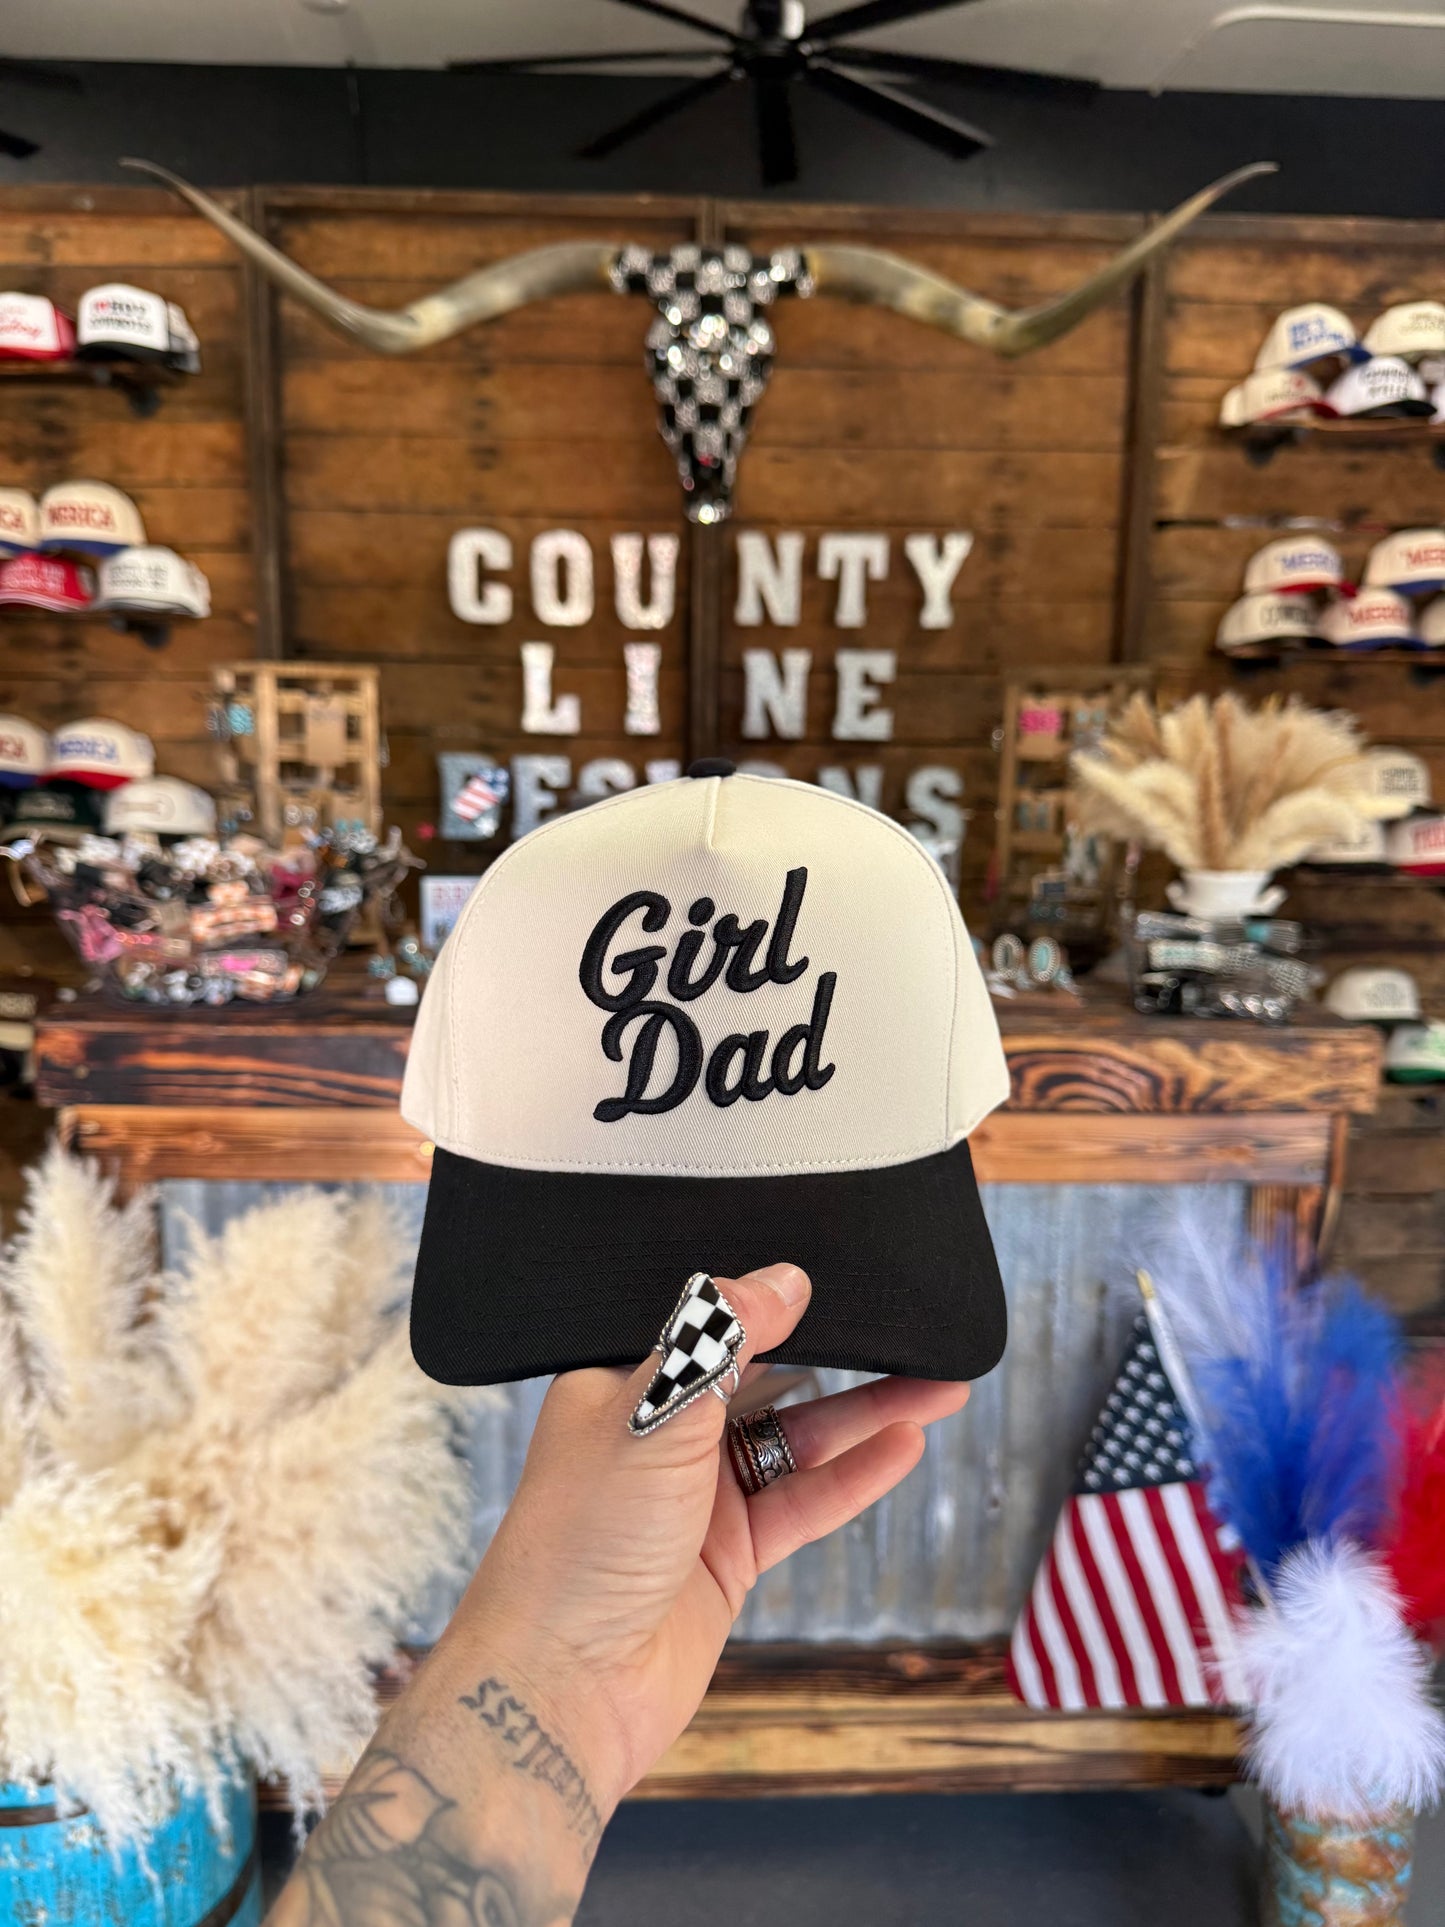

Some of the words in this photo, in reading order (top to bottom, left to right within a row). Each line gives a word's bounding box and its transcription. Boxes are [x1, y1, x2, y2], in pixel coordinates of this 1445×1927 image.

[447, 528, 974, 629] COUNTY
[520, 642, 898, 741] LINE
[438, 752, 966, 842] DENS
[579, 866, 809, 1012] Girl
[592, 971, 837, 1122] Dad
